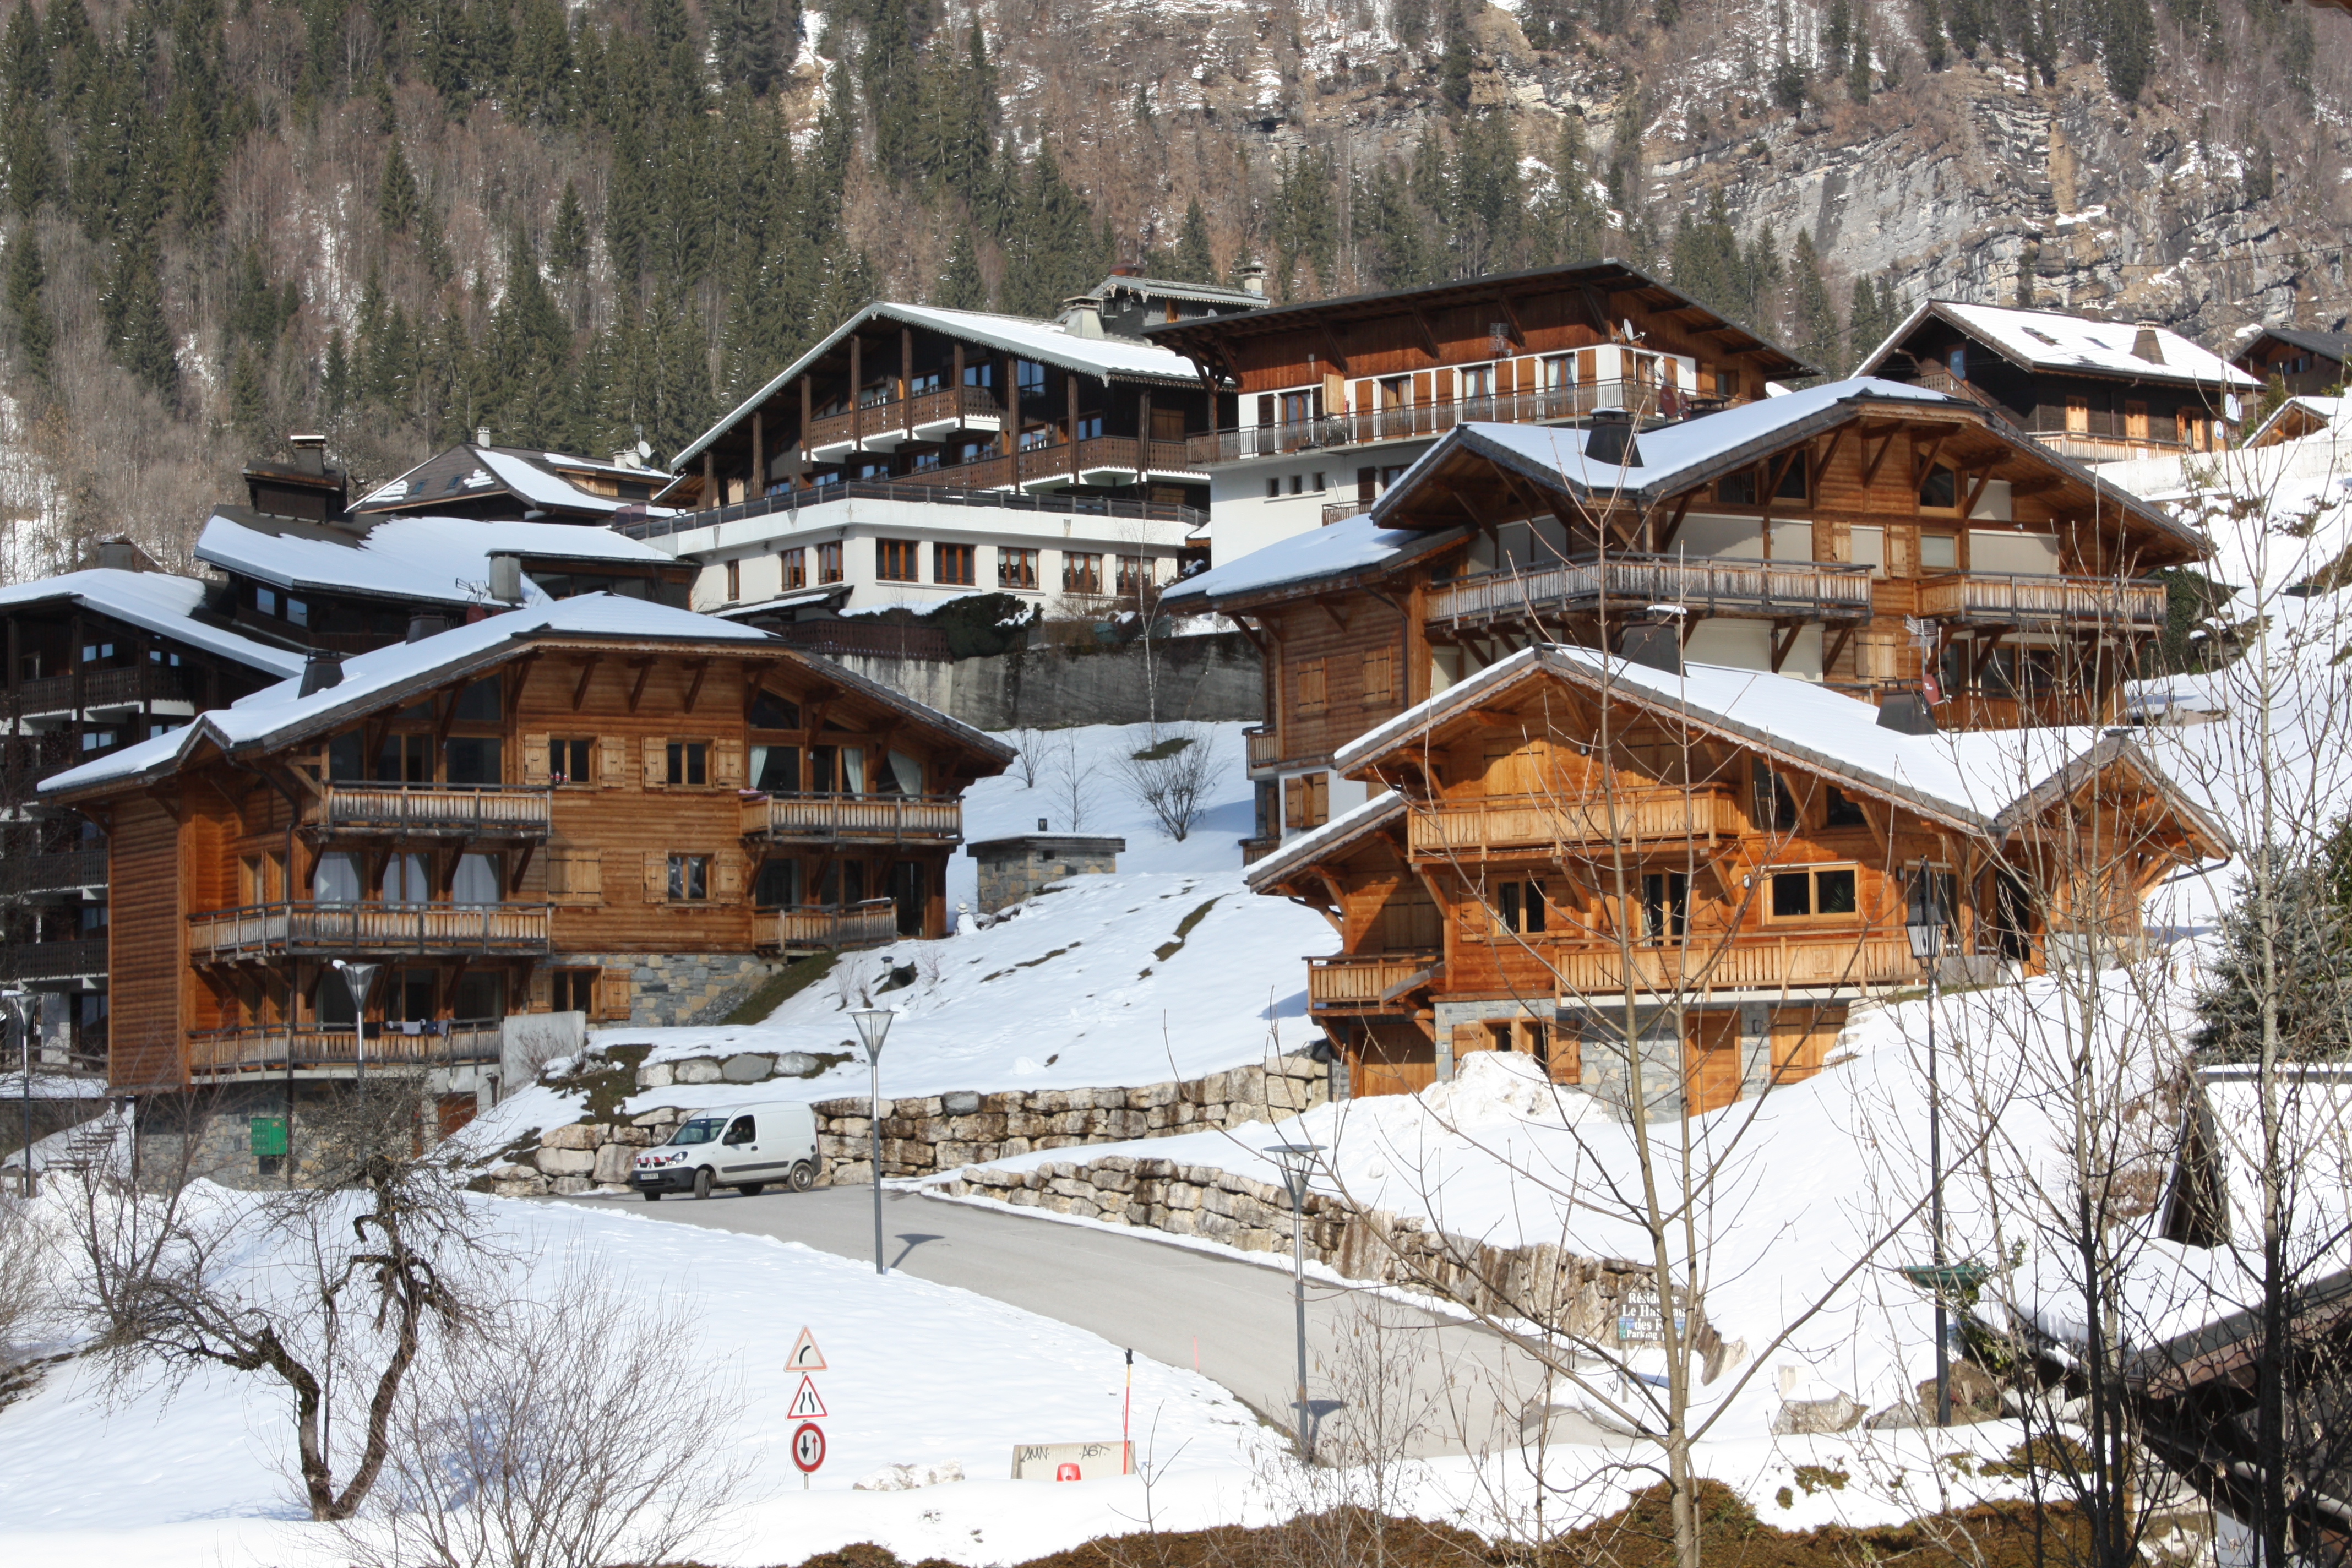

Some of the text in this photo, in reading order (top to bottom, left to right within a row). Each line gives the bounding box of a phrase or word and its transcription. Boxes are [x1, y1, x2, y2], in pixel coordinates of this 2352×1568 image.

[1628, 1292, 1679, 1304] Réside
[1622, 1304, 1686, 1317] Le Haau
[1634, 1317, 1652, 1331] des
